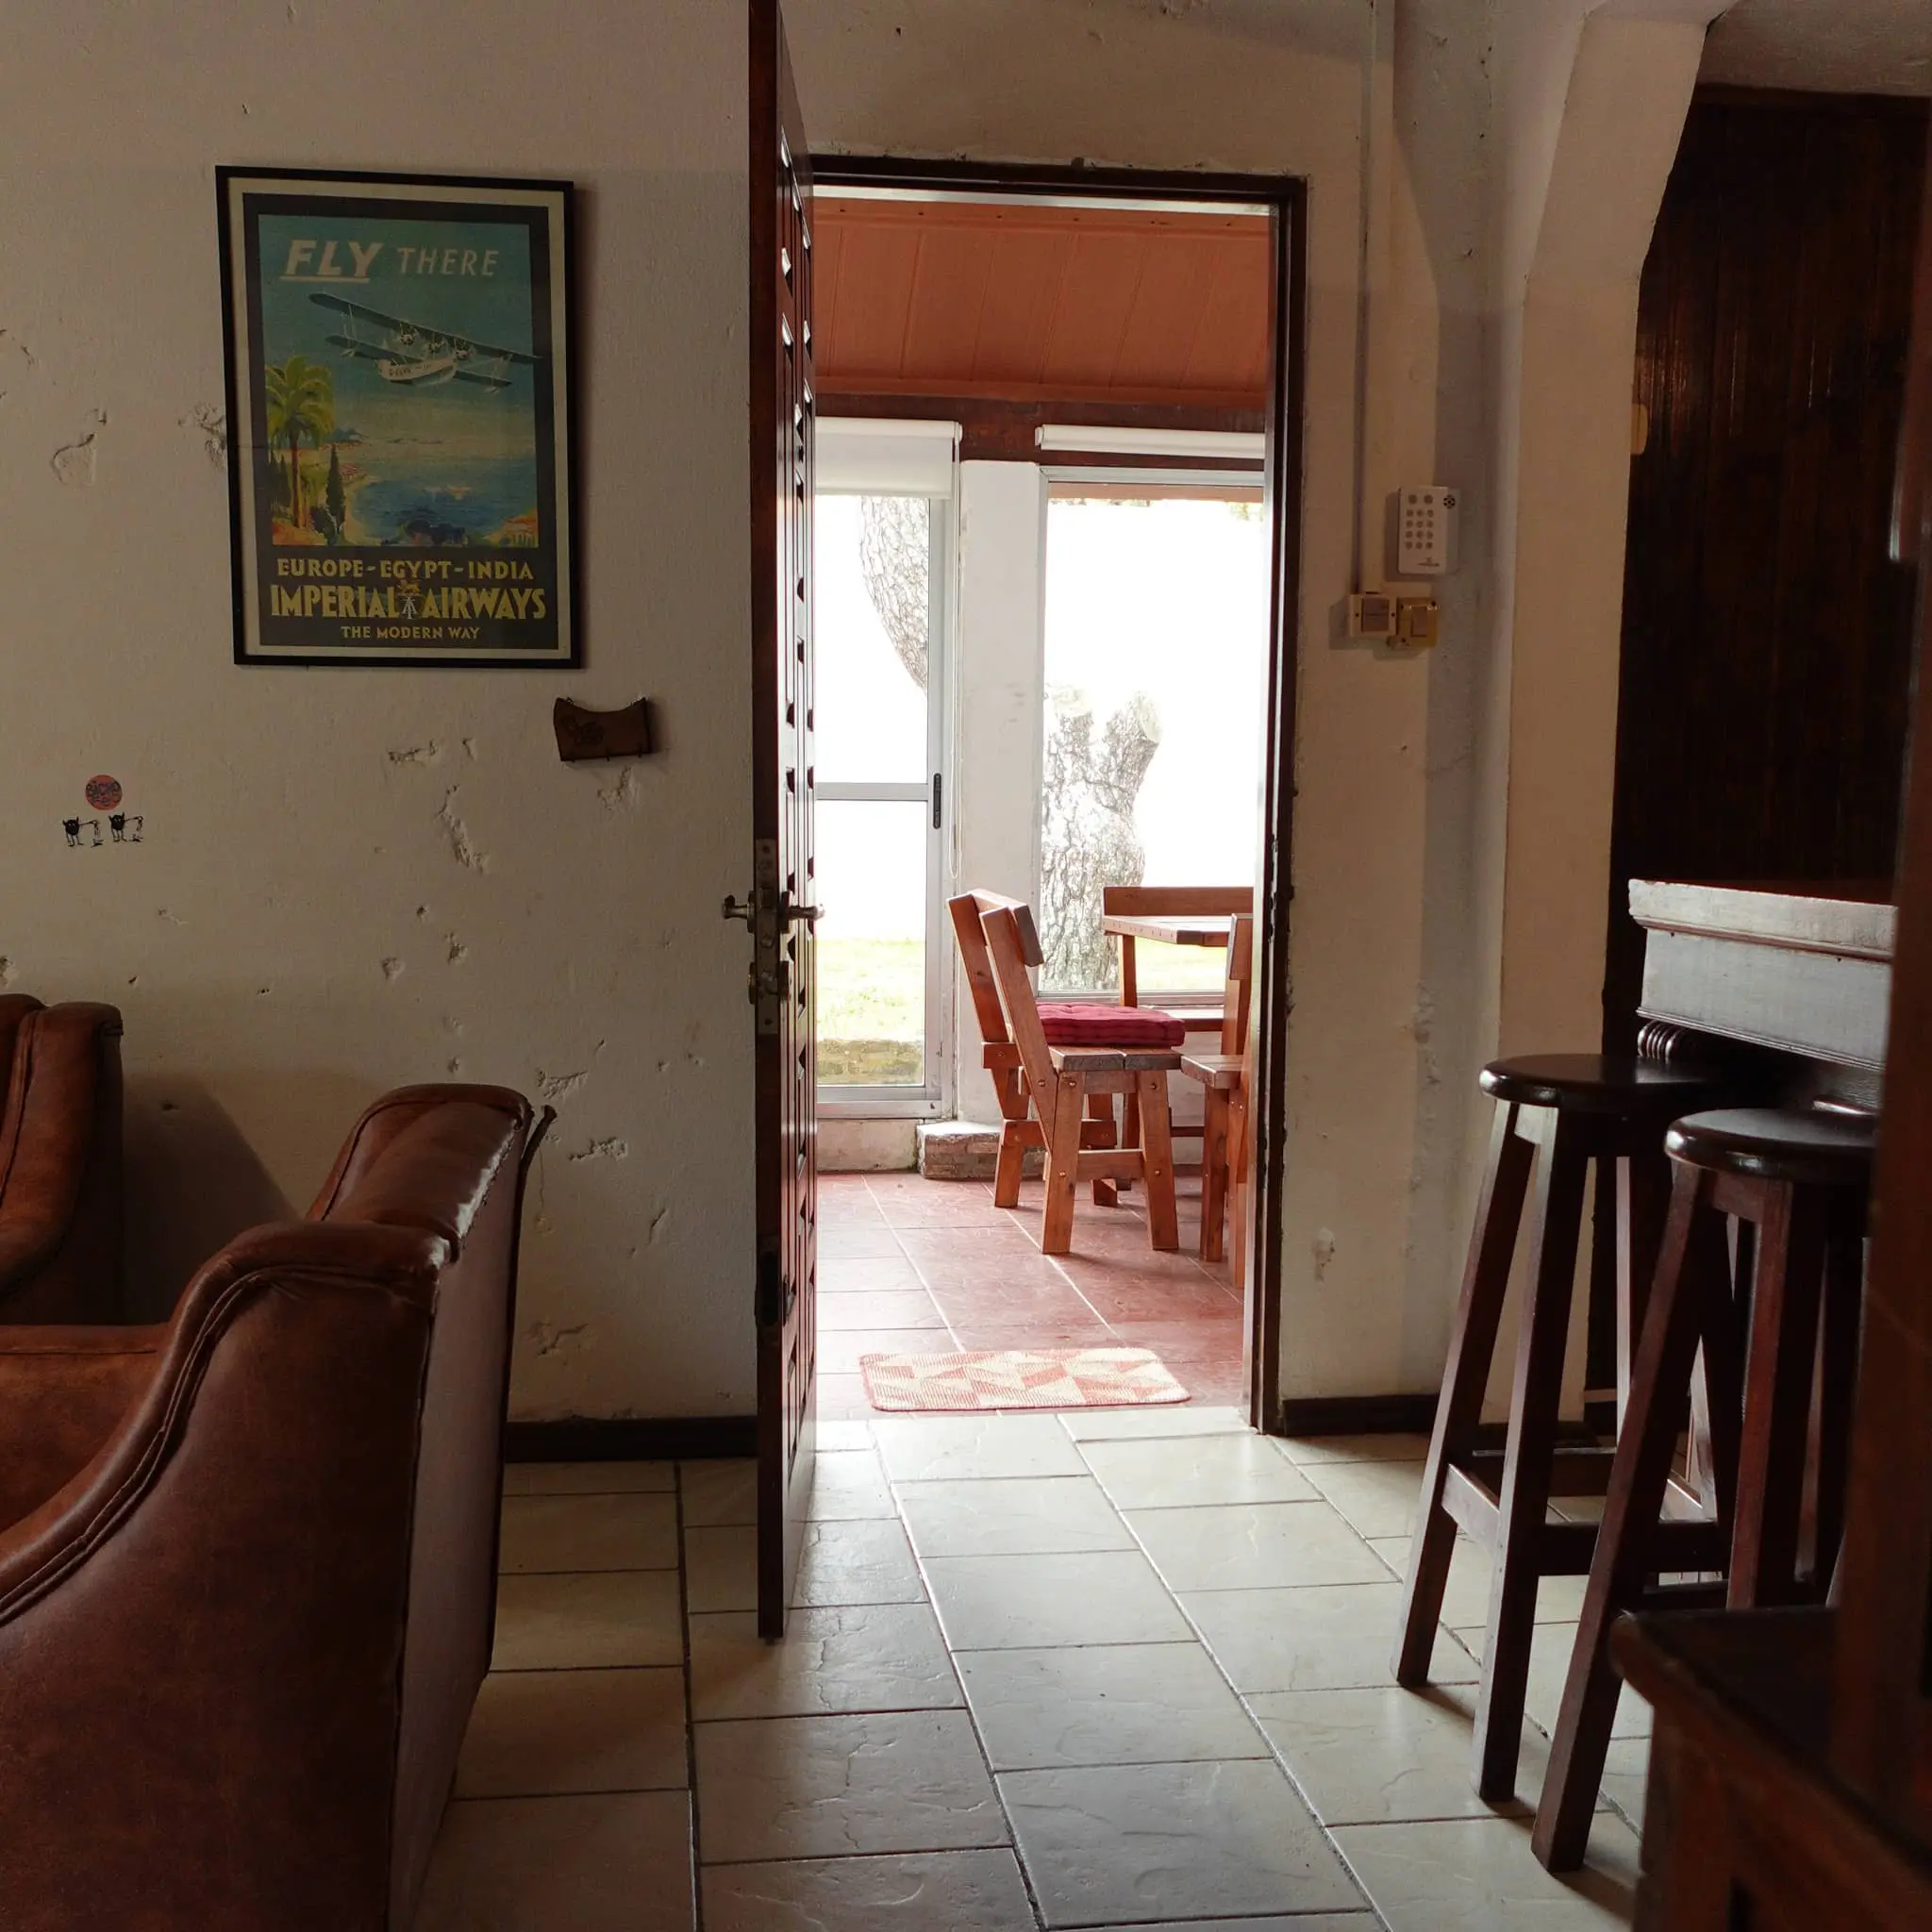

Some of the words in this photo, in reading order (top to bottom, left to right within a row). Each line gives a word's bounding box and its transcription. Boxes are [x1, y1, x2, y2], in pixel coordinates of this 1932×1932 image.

[285, 239, 384, 277] FLY
[396, 246, 500, 277] THERE
[270, 584, 398, 619] IMPERIAL
[421, 588, 547, 620] AIRWAYS
[341, 625, 371, 639] THE
[376, 626, 442, 640] MODERN
[448, 627, 480, 640] WAY
